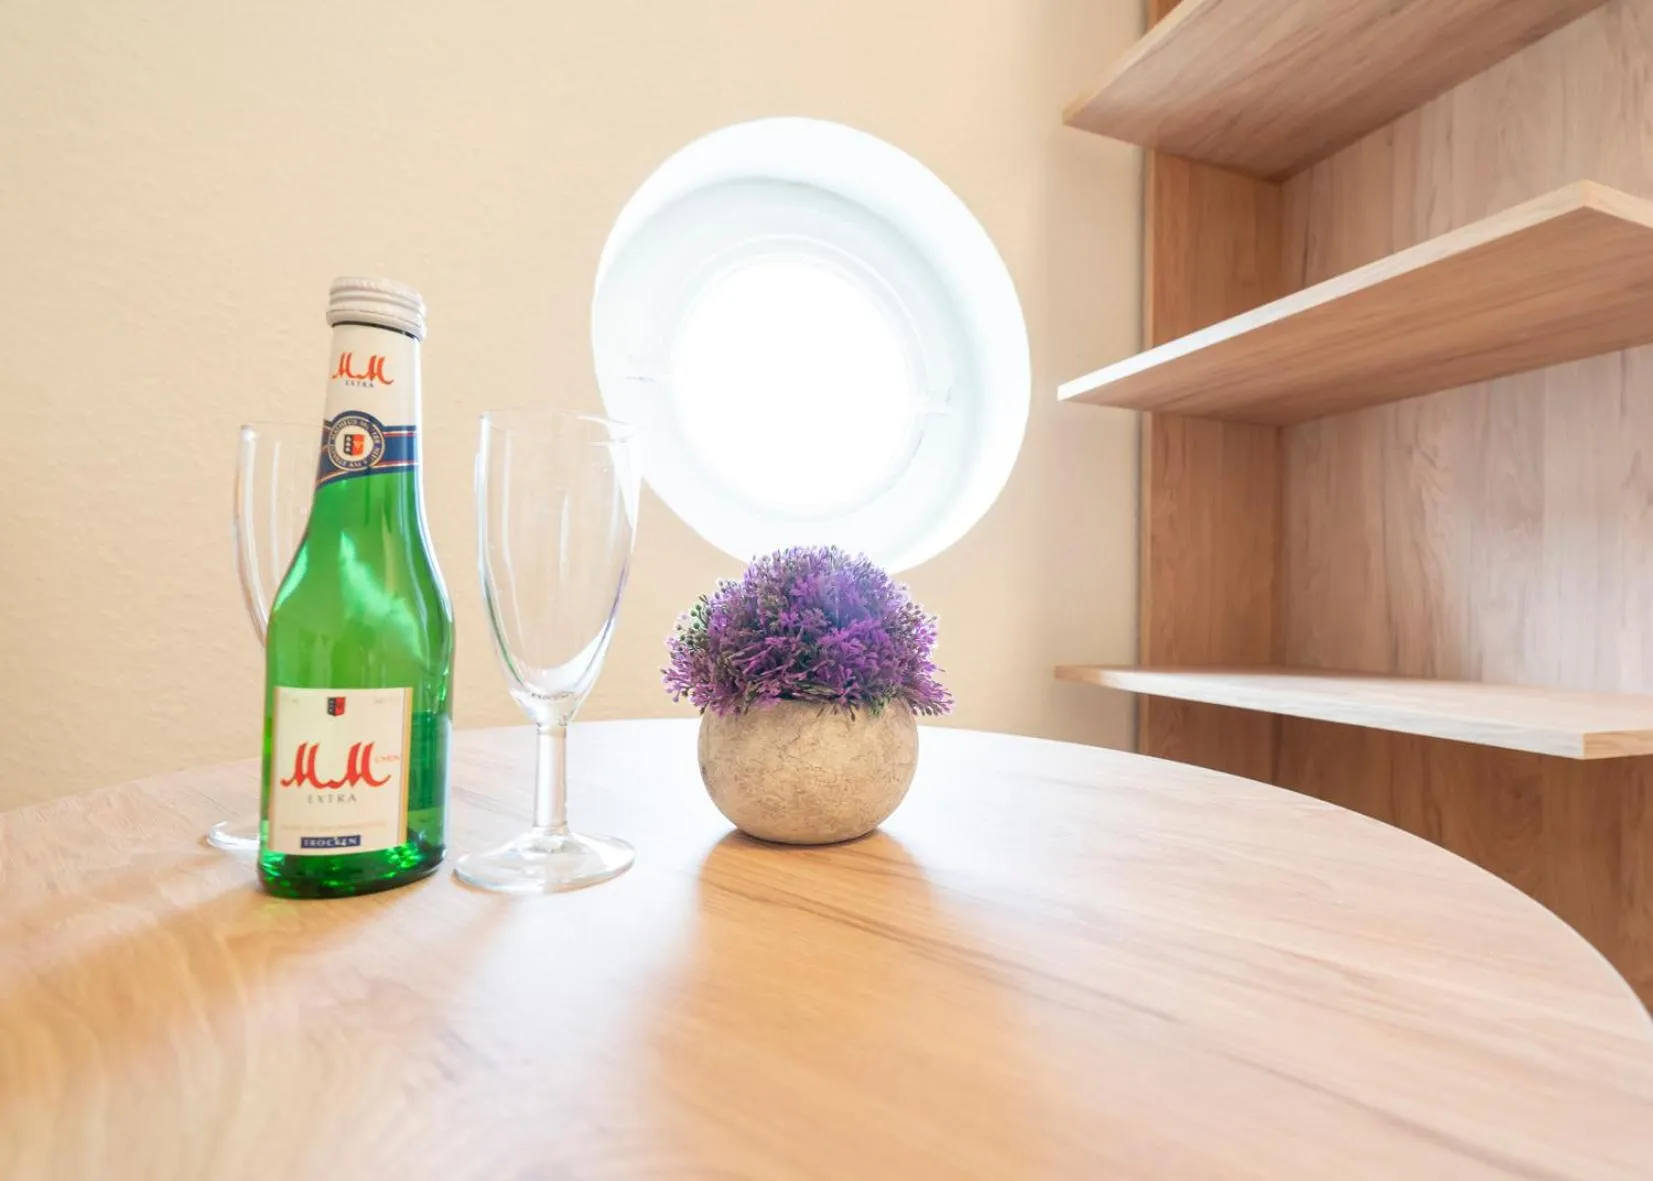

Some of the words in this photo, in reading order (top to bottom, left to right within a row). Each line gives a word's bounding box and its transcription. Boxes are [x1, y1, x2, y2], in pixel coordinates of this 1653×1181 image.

[332, 352, 394, 385] MM
[344, 380, 374, 388] EXTRA
[280, 742, 392, 789] MM
[307, 793, 358, 804] EXTRA
[303, 836, 358, 847] TROCKEN
